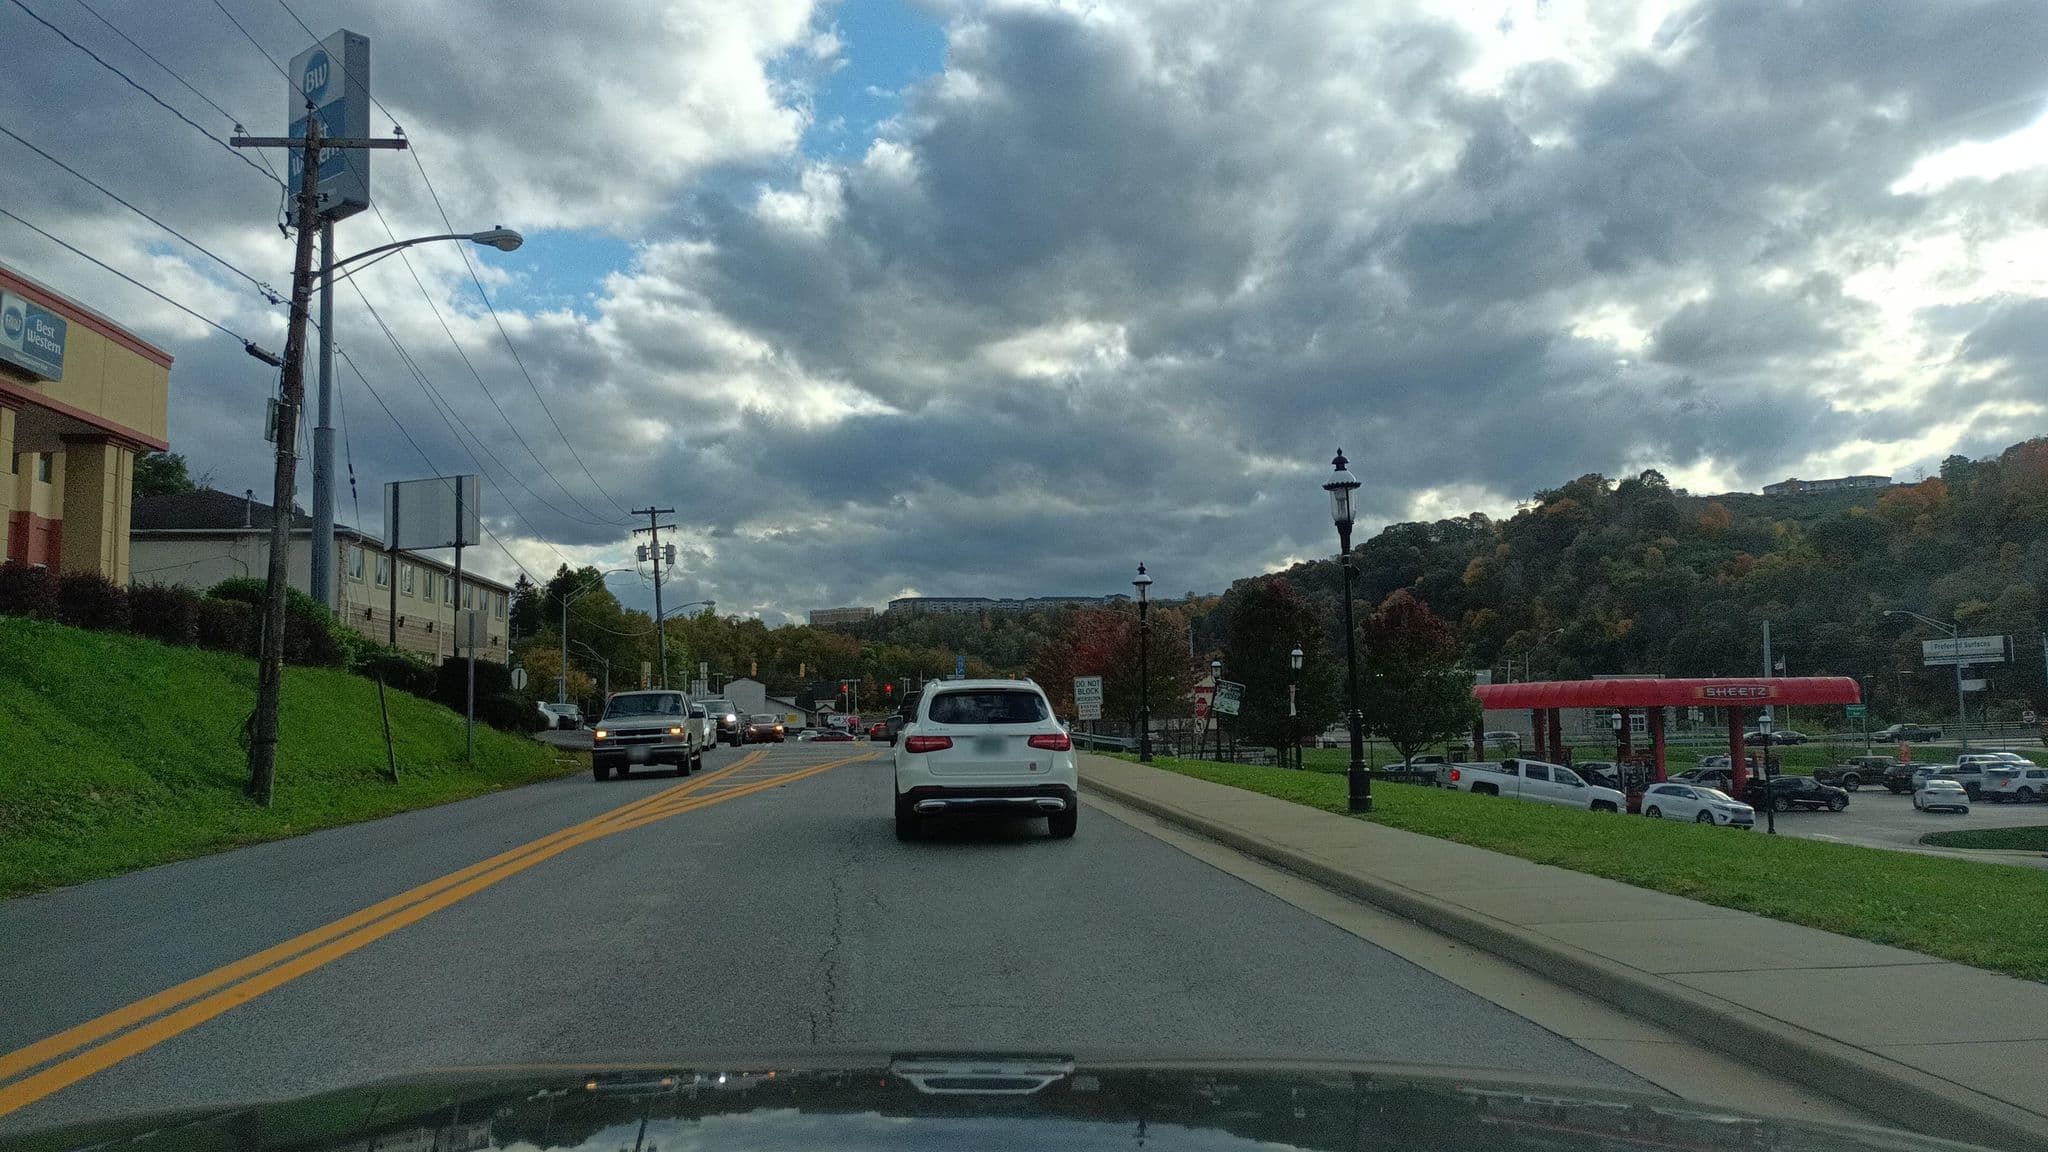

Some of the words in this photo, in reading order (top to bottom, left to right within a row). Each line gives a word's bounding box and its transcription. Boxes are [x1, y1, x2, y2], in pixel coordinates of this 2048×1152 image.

[306, 63, 328, 94] BW
[36, 319, 56, 339] Best
[27, 328, 61, 355] Western
[1076, 680, 1085, 688] DO
[1087, 679, 1100, 688] NOT
[1077, 687, 1099, 696] BLOCK
[1706, 687, 1767, 697] SHEETZ
